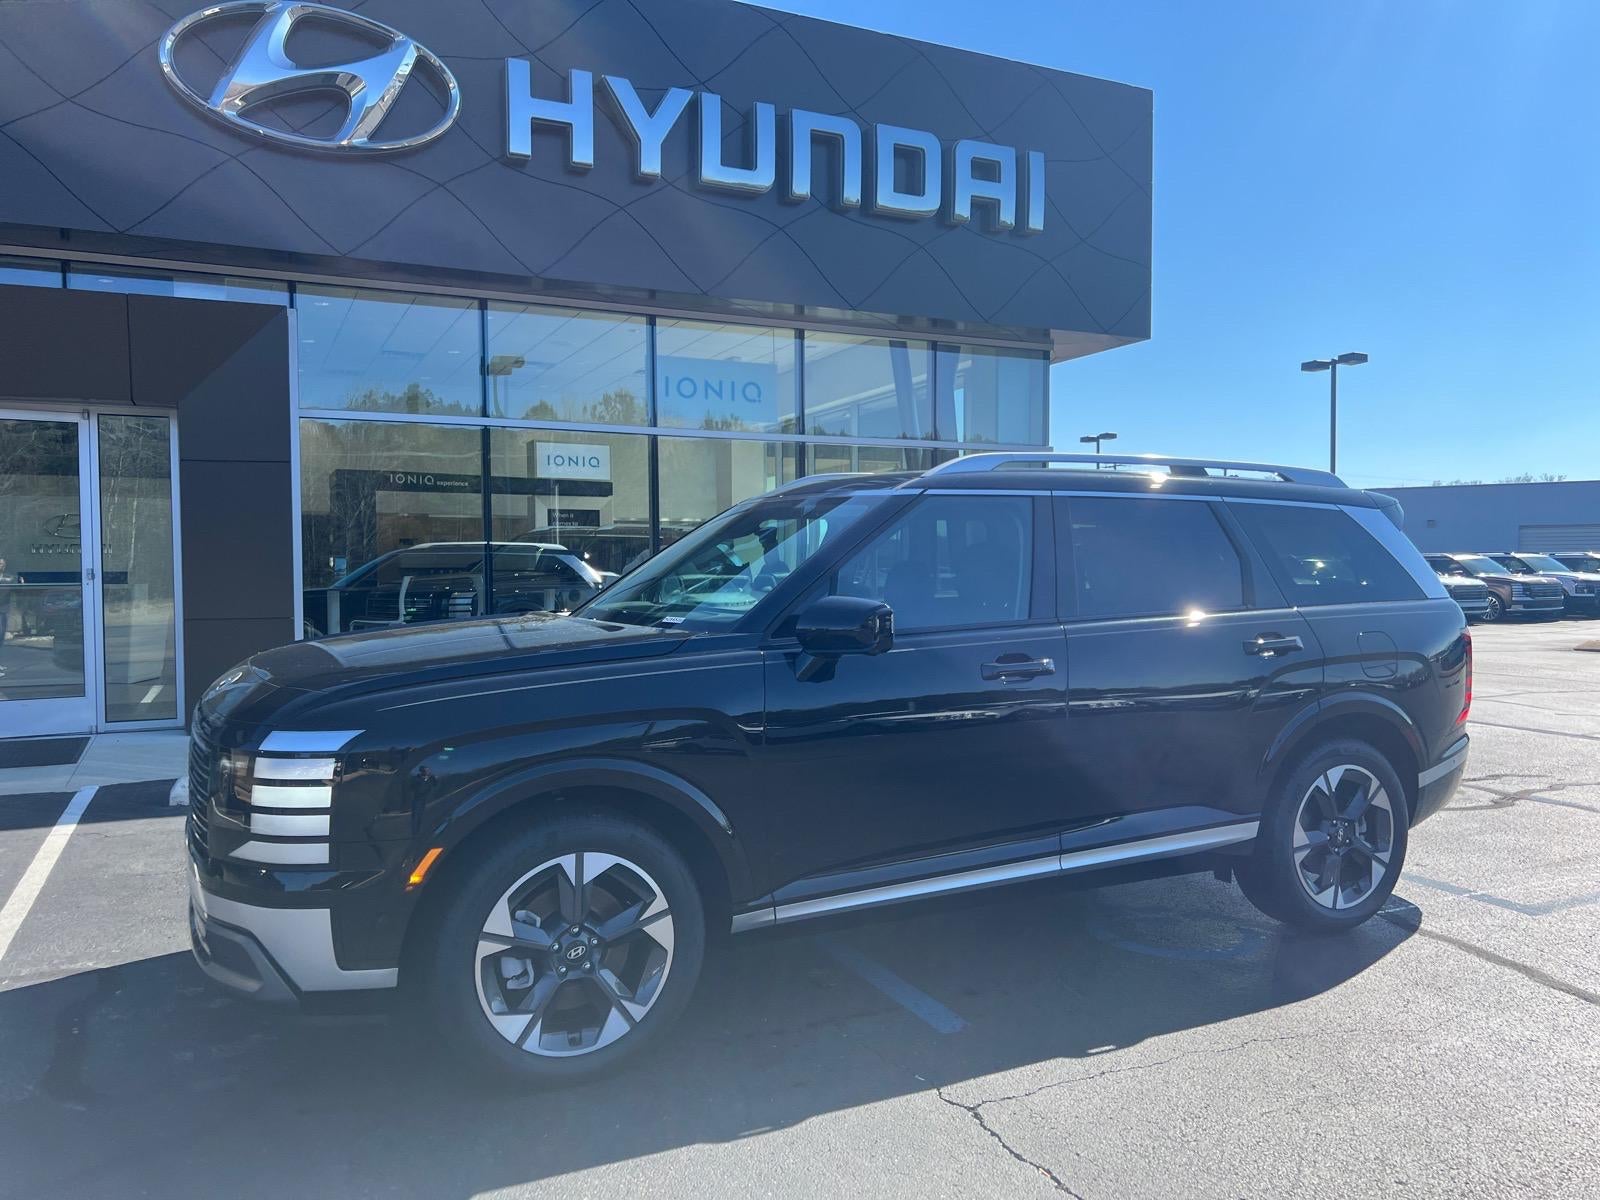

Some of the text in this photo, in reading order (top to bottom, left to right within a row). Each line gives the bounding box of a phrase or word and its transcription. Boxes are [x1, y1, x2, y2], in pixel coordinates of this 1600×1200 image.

[505, 57, 1045, 233] HYUNDAI
[665, 375, 762, 403] IONIQ
[547, 454, 600, 468] IONIQ
[390, 473, 434, 485] IONIQ
